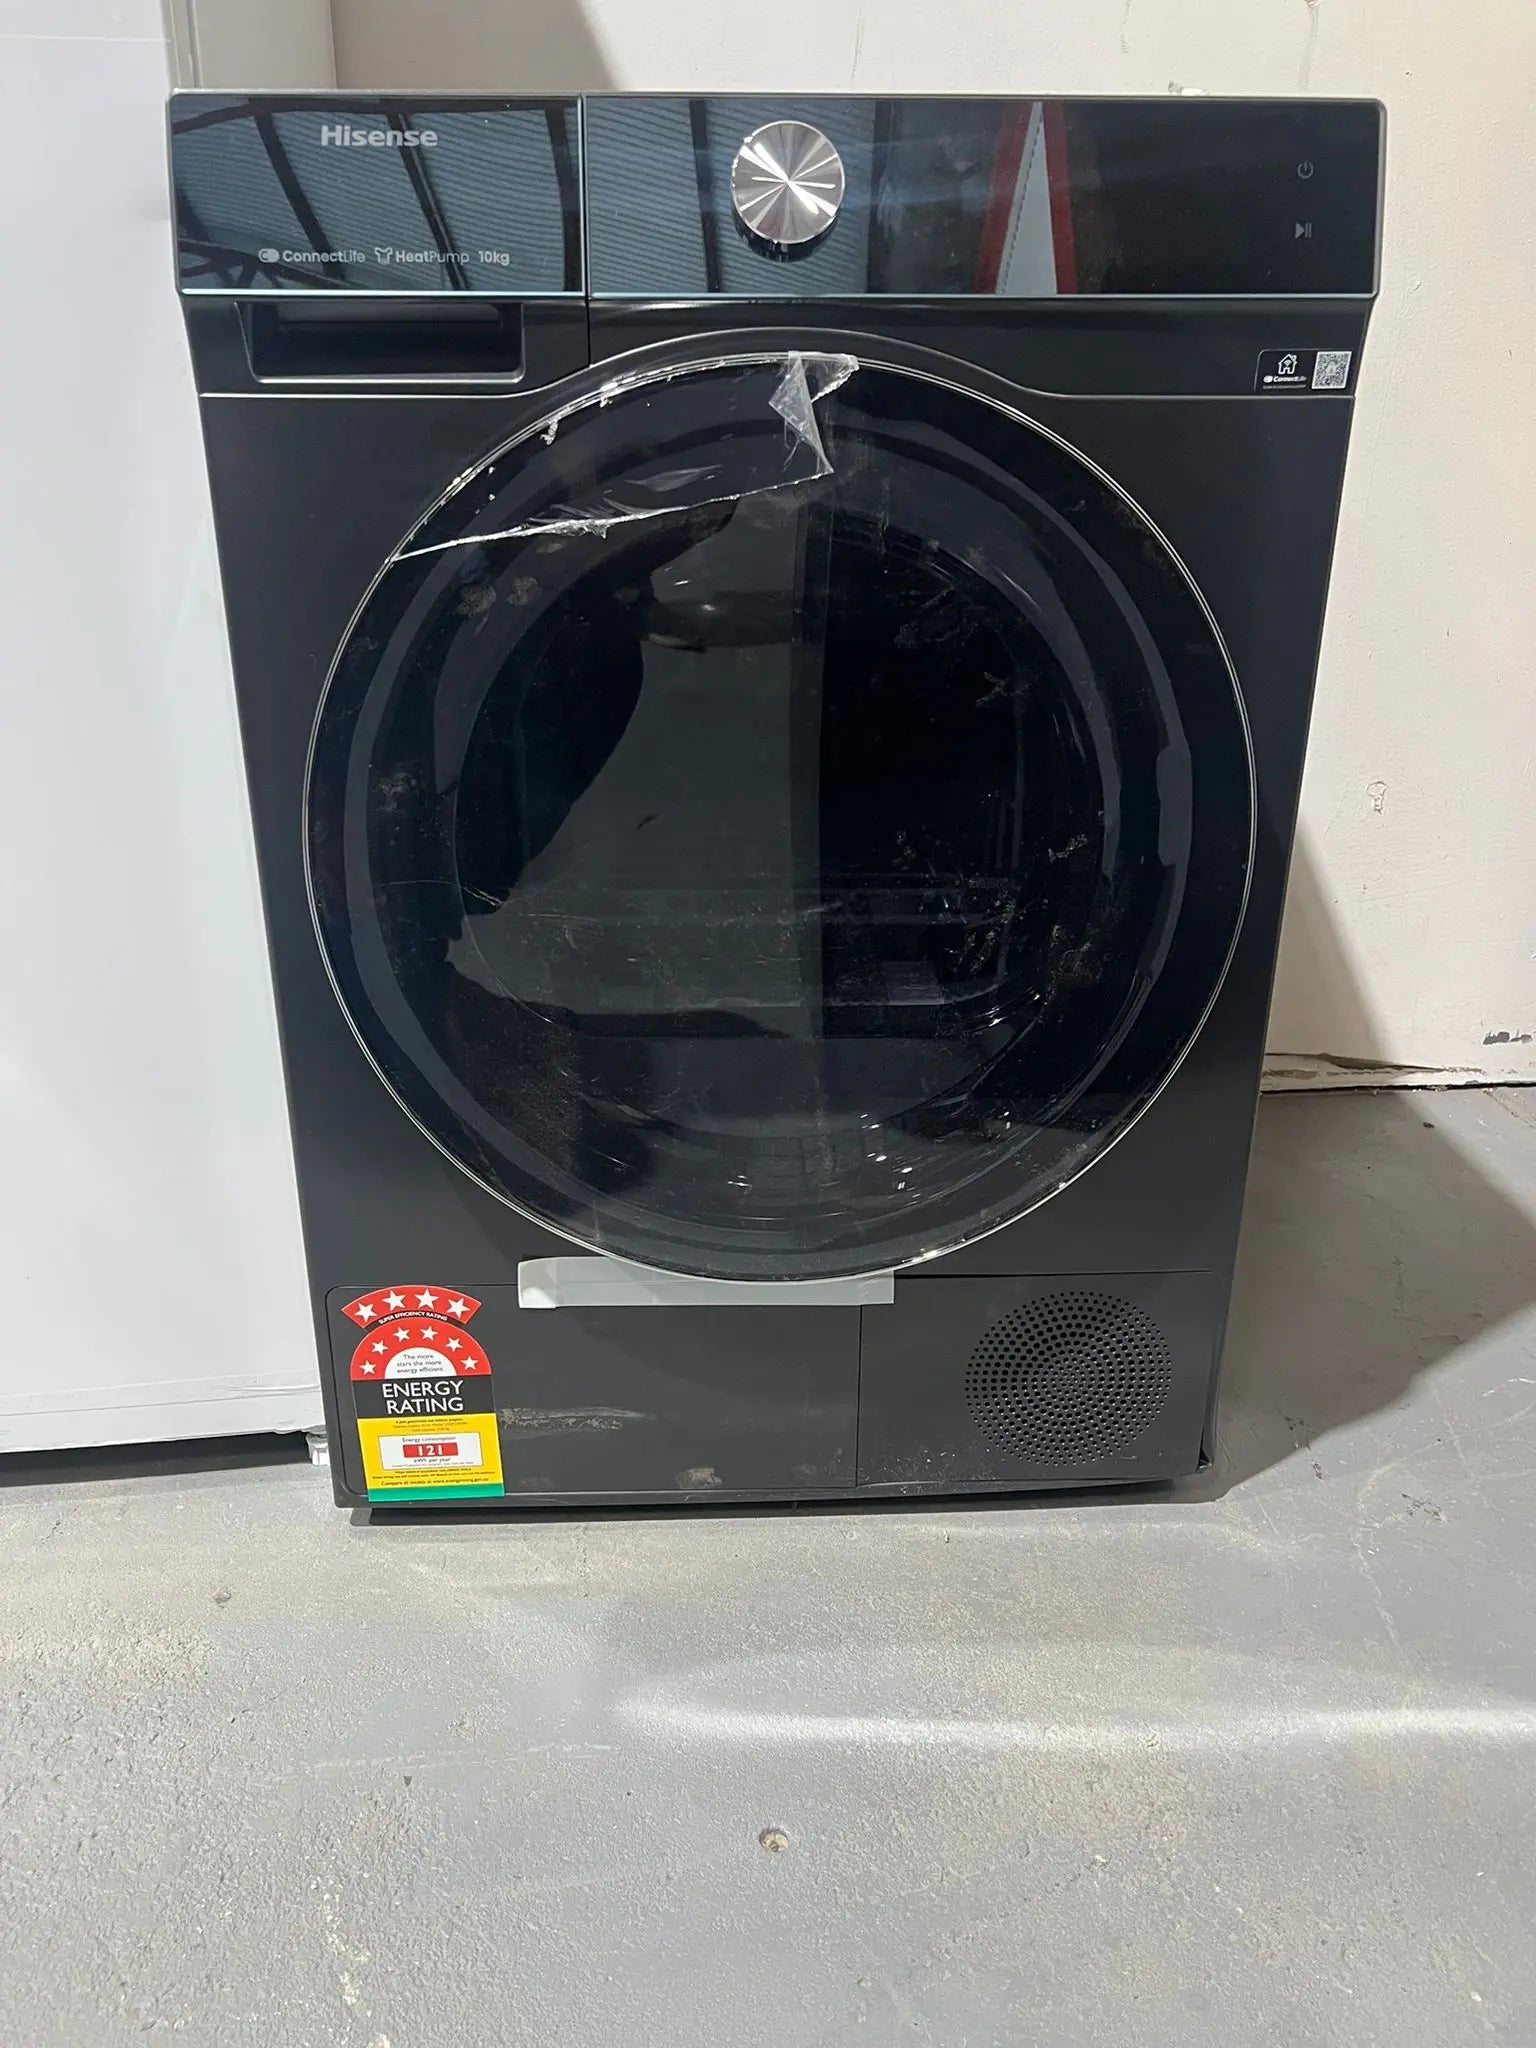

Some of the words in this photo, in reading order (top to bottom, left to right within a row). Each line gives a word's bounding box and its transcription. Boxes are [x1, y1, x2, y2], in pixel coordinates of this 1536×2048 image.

[320, 125, 439, 147] Hisense
[282, 250, 366, 263] ConnectLife
[395, 250, 470, 265] HeatPump
[478, 250, 510, 266] 10kg
[378, 1315, 395, 1324] SUPER
[394, 1311, 425, 1319] EFFICIENCY
[425, 1312, 448, 1321] RATING
[382, 1380, 464, 1398] ENERGY
[386, 1397, 464, 1415] RATING
[418, 1444, 443, 1456] 121
